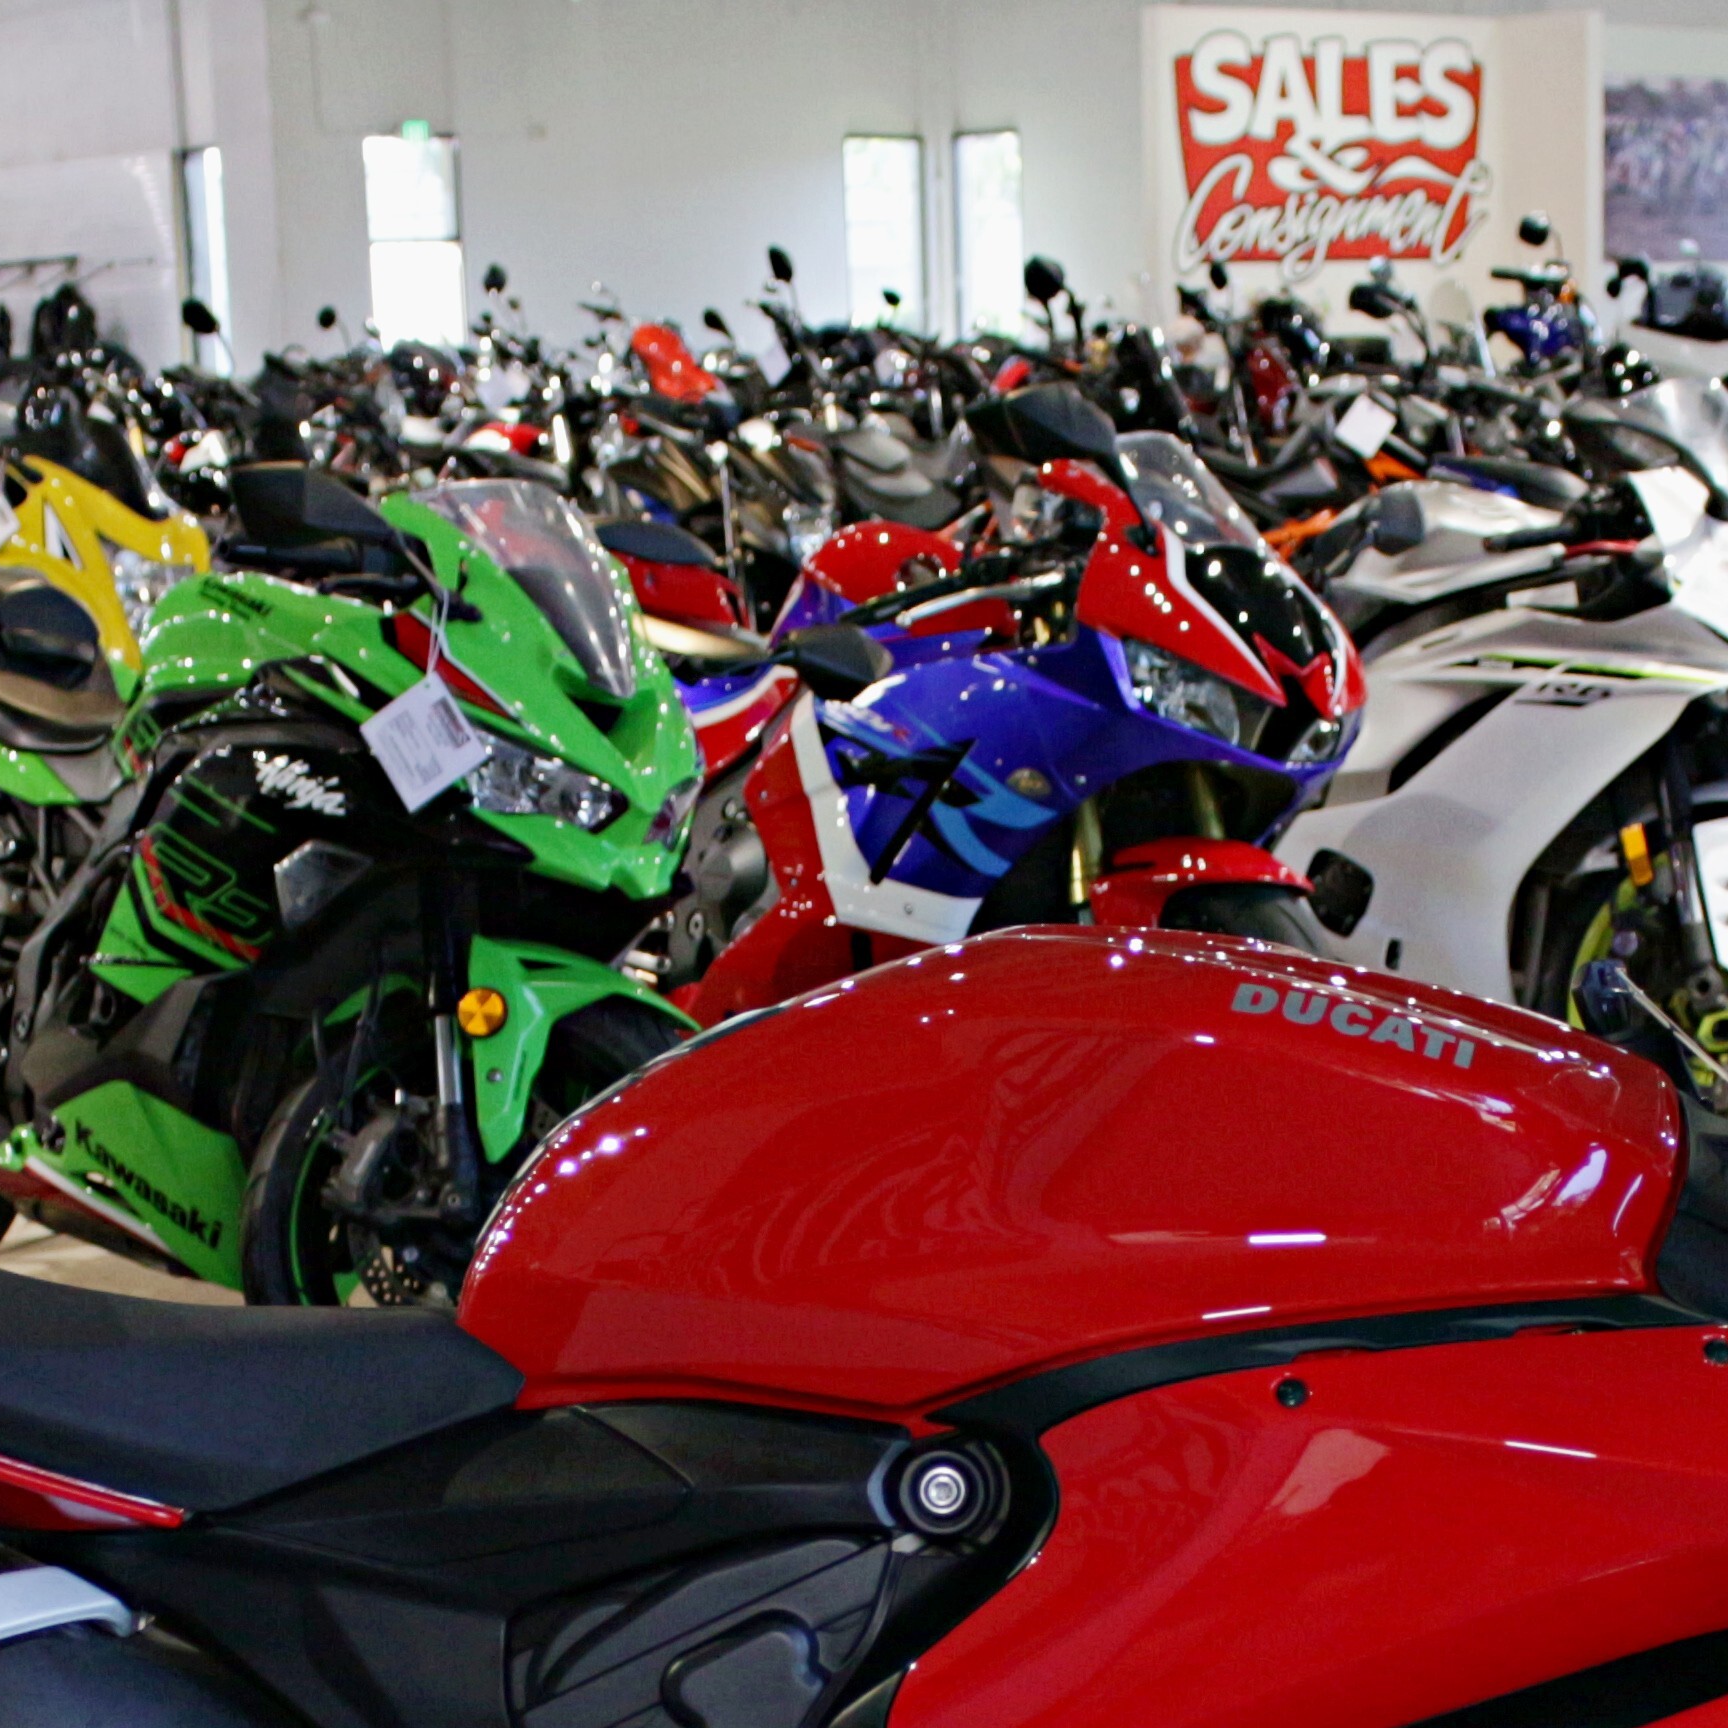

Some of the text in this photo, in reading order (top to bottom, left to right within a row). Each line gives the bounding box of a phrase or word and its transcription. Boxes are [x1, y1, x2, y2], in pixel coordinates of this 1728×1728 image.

[1186, 28, 1478, 150] SALES
[1172, 150, 1493, 284] Consignment
[1266, 134, 1385, 197] &
[254, 753, 347, 817] Ninja
[1230, 982, 1476, 1070] DUCATI
[74, 1117, 223, 1250] Kawasaki
